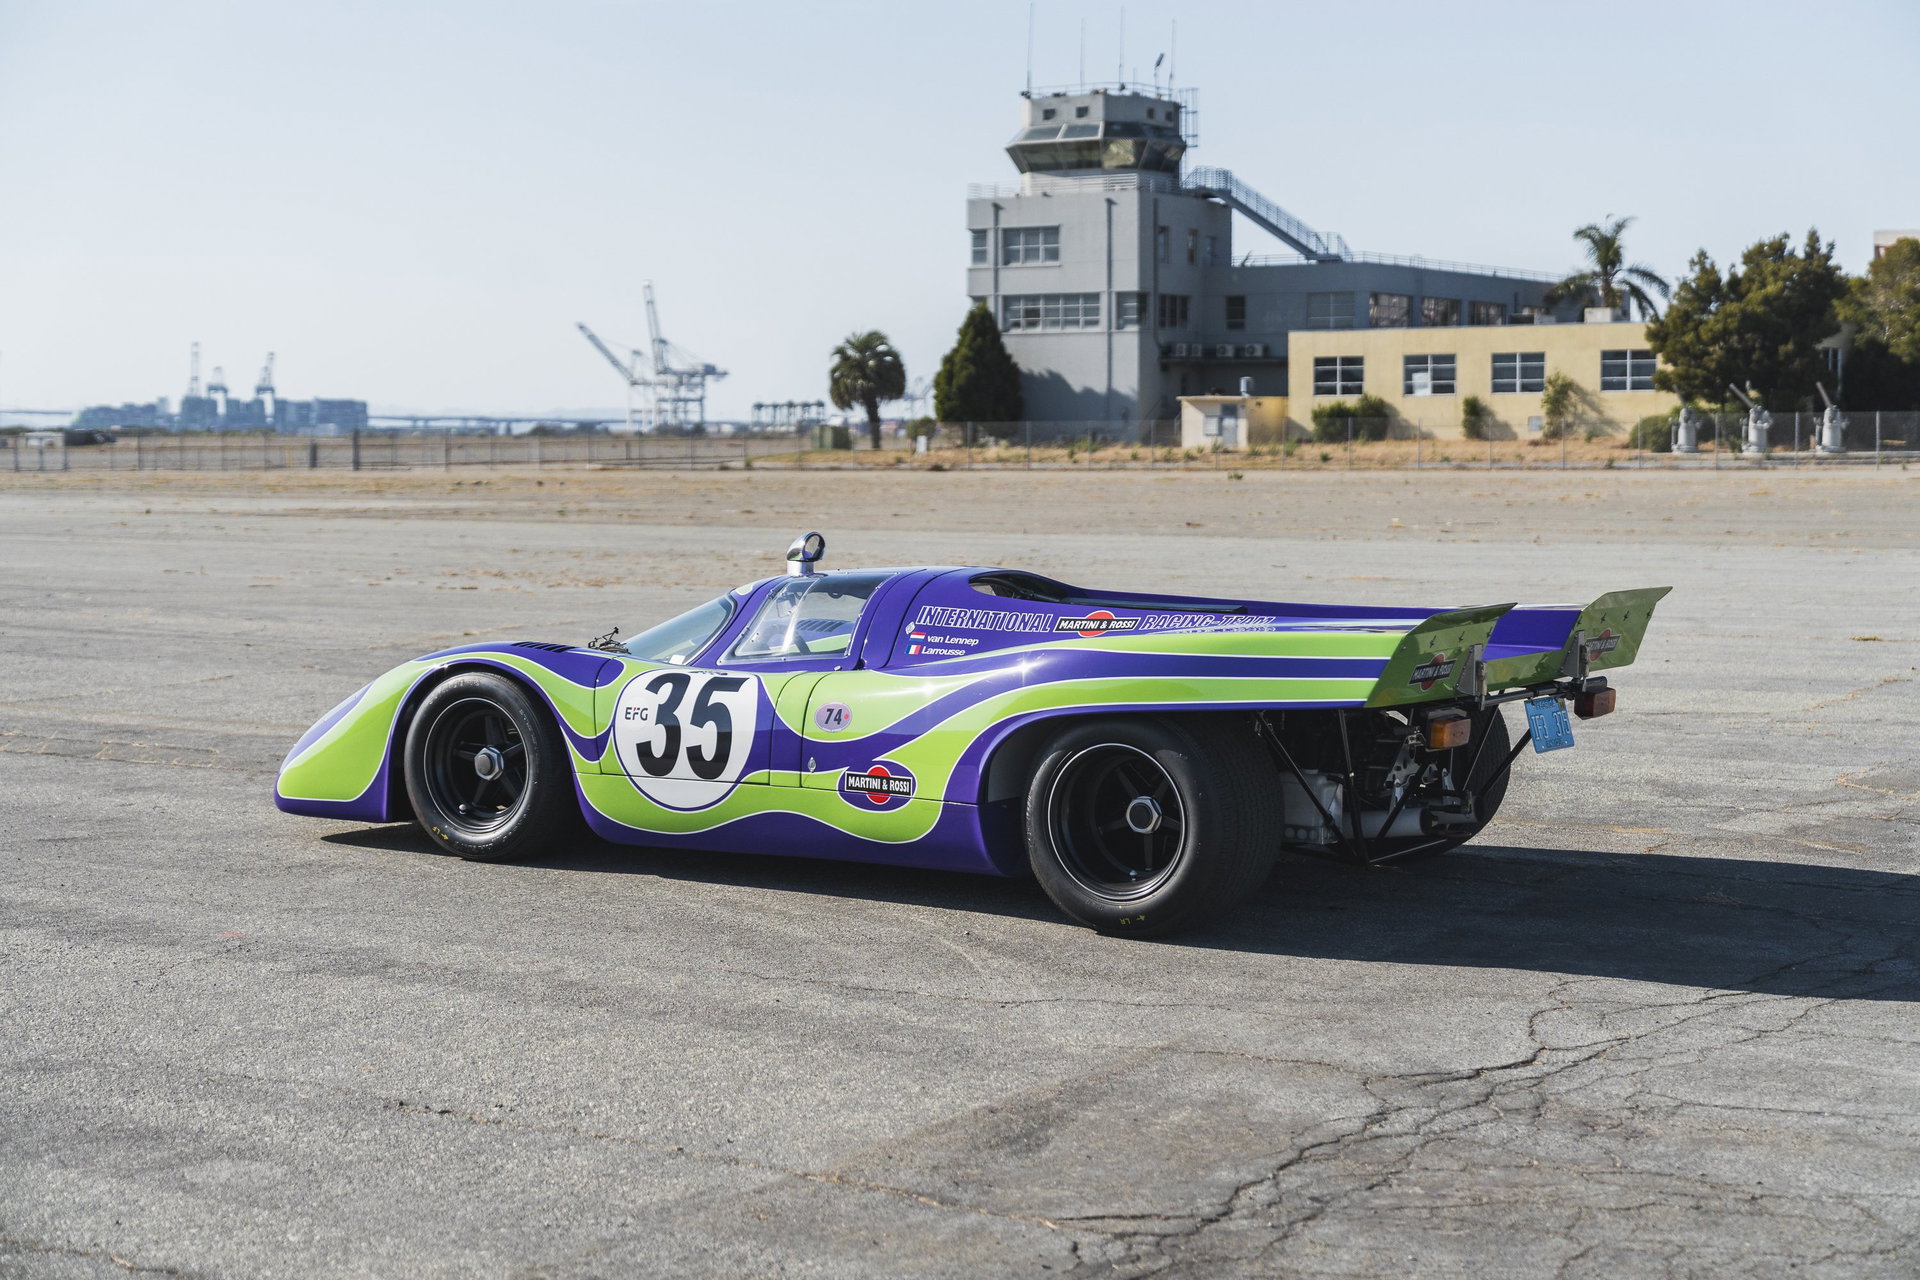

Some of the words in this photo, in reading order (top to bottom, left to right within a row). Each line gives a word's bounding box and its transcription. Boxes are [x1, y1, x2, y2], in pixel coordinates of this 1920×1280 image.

[915, 605, 1053, 633] INTERNATIONAL
[1059, 620, 1100, 630] MARTINI
[1100, 620, 1107, 629] &
[1108, 620, 1136, 629] ROSSI
[927, 635, 944, 643] van
[945, 635, 979, 647] Lennep
[921, 646, 966, 656] Larrousse
[625, 707, 648, 721] EFG
[824, 708, 843, 725] 74
[636, 672, 750, 780] 35
[848, 775, 880, 790] MARTINI
[882, 779, 888, 790] &
[889, 780, 910, 793] ROSSI
